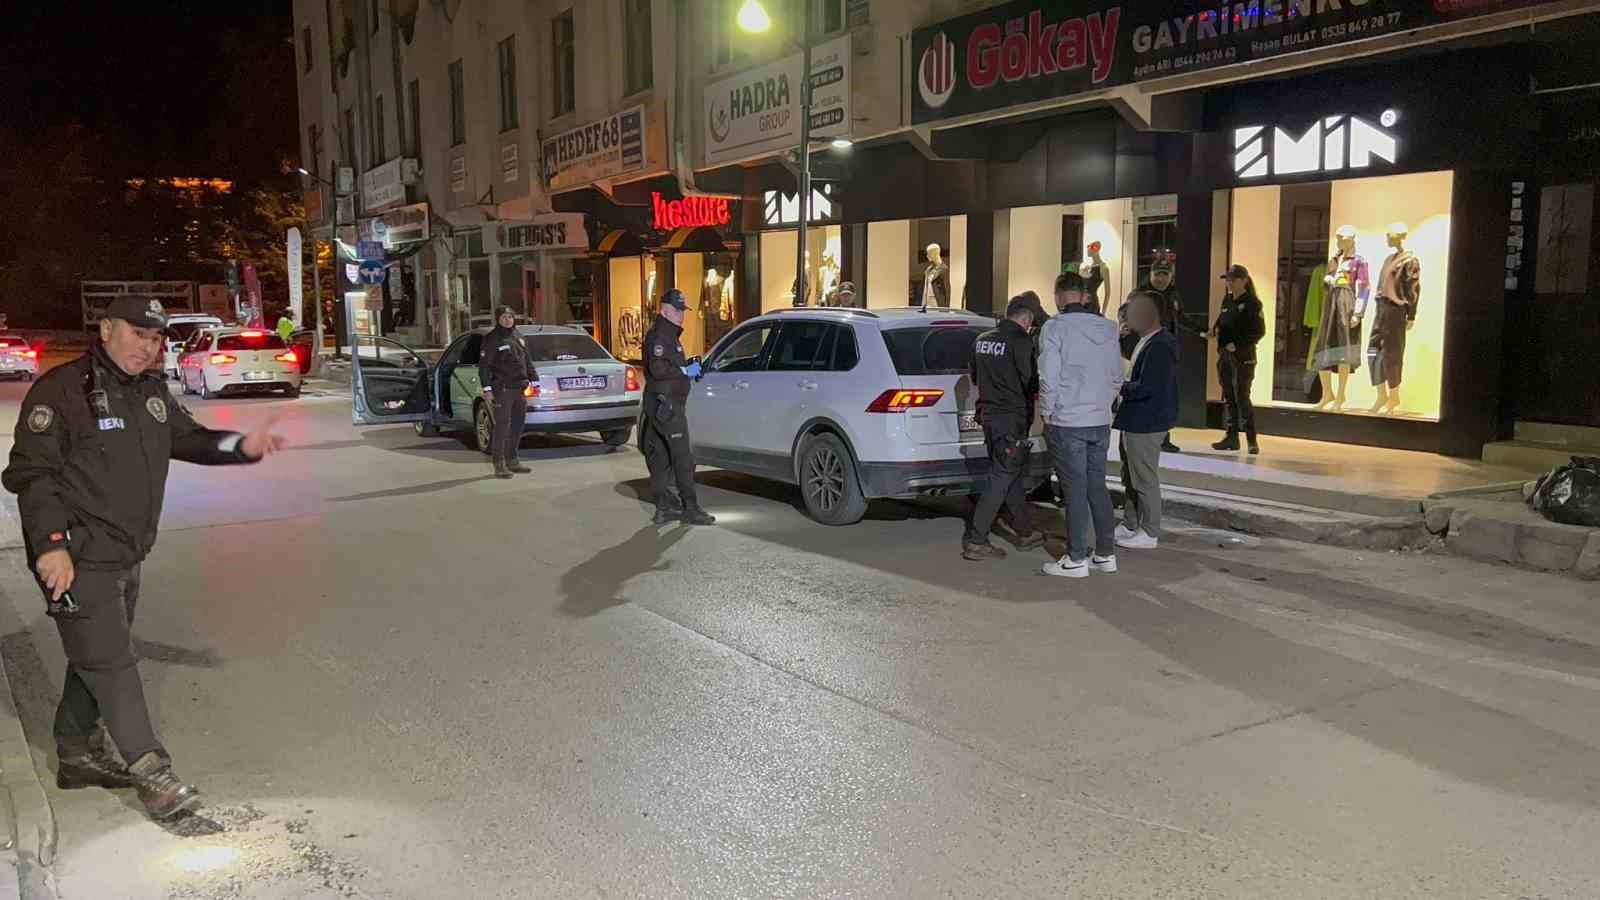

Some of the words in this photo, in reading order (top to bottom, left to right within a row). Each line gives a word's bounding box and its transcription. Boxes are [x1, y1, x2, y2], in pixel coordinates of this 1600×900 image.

[966, 7, 1120, 88] Gökay
[1132, 0, 1369, 52] GAYRİMEN
[1282, 30, 1317, 46] BULAT
[730, 72, 790, 120] HADRA
[558, 117, 620, 161] HEDEF68
[759, 110, 791, 132] GROUP
